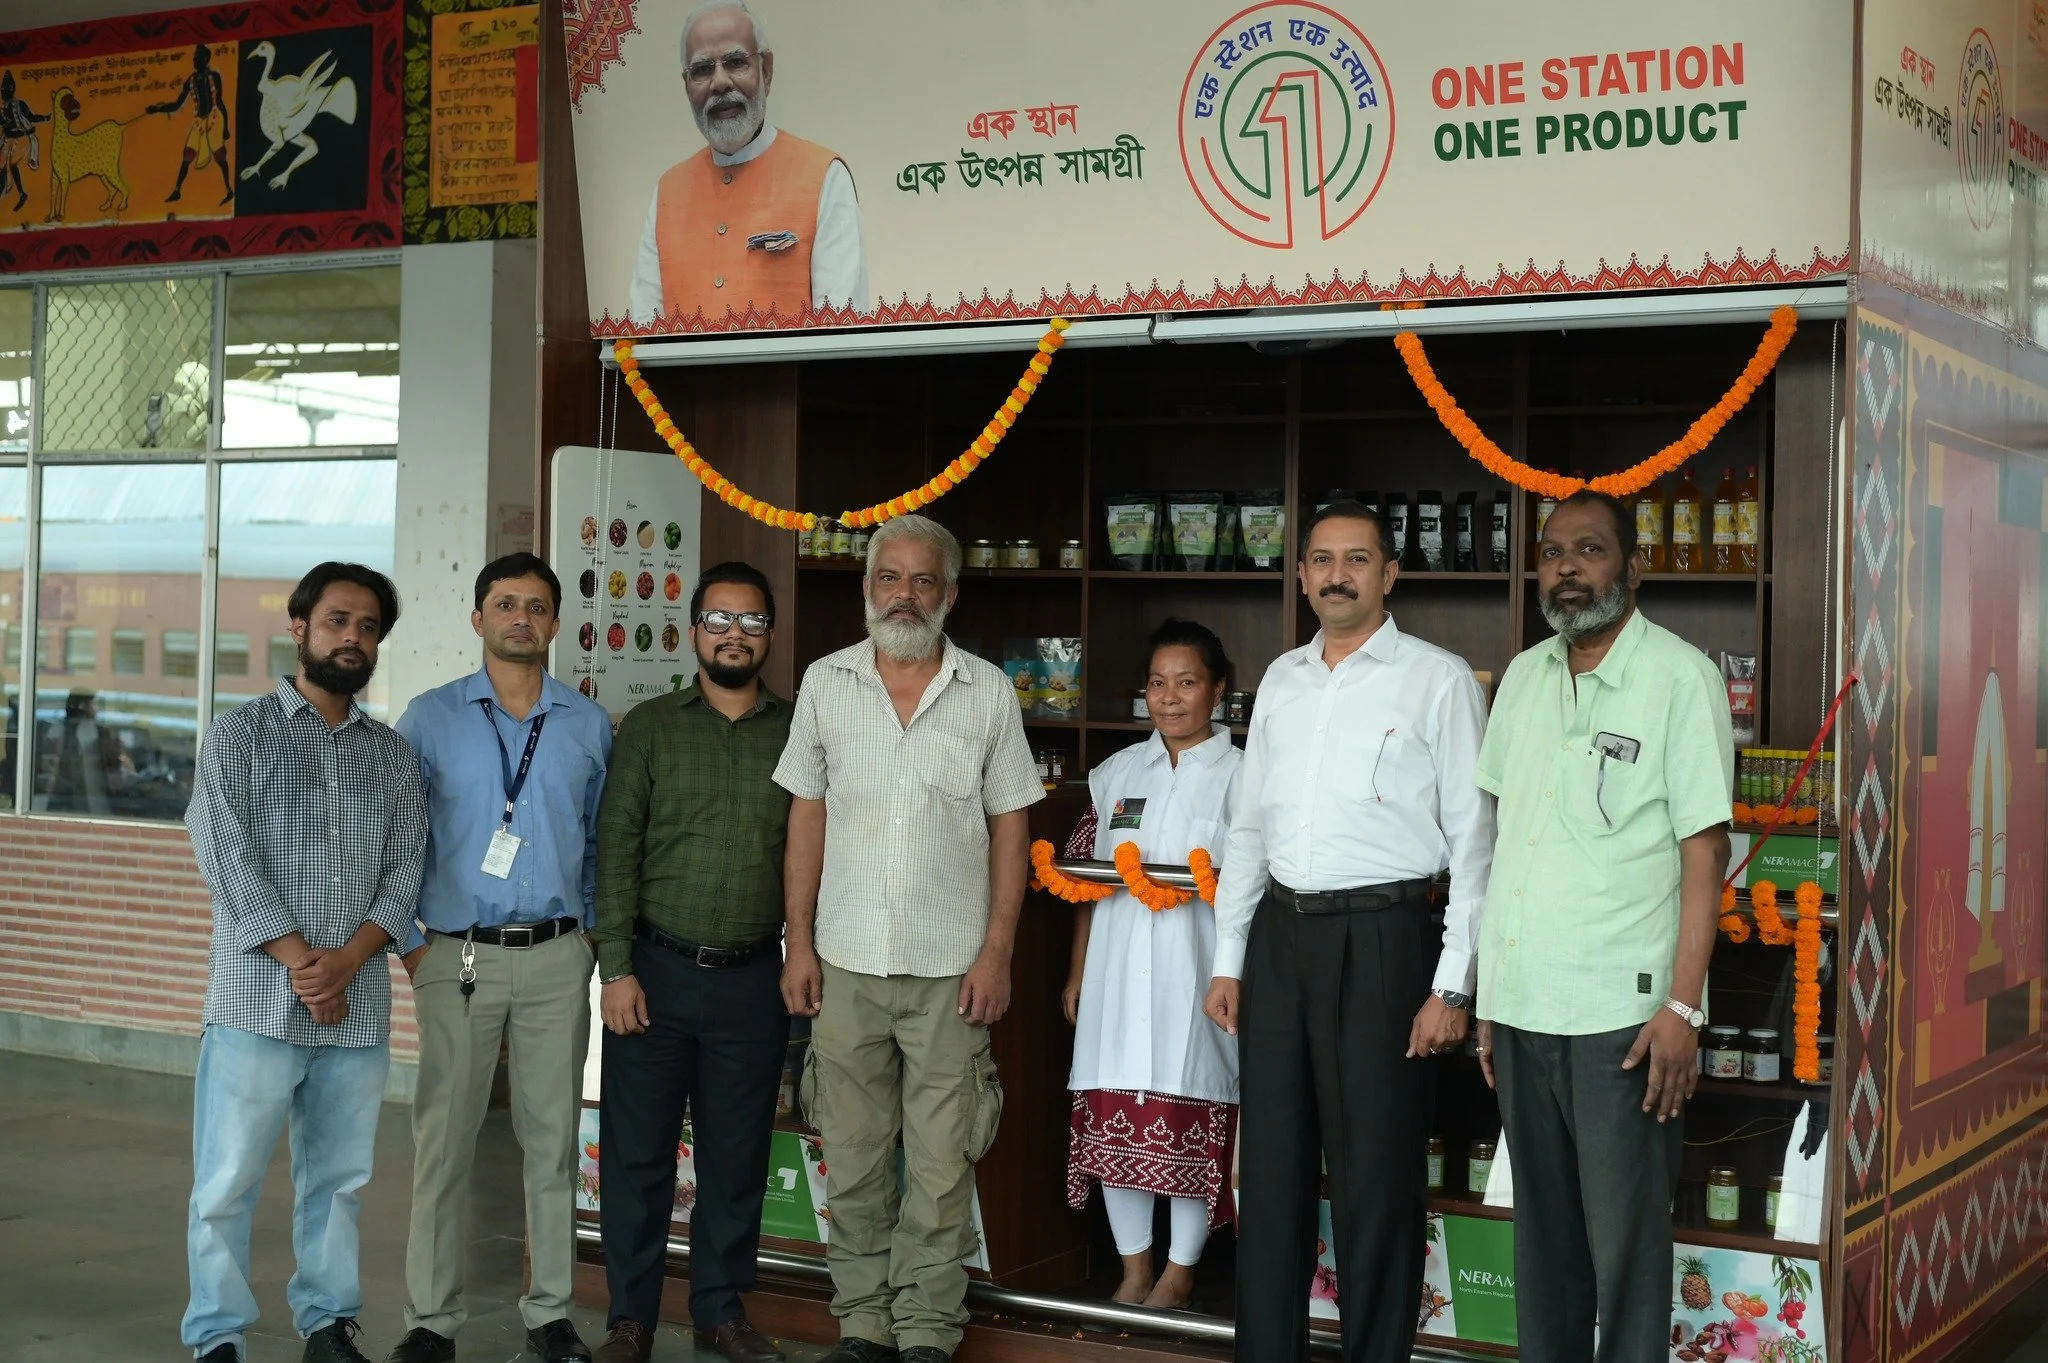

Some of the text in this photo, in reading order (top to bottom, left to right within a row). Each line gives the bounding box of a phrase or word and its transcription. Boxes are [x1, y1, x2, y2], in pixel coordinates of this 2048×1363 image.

[1195, 19, 1378, 120] एक स्टेशन एक उत्पाद
[1432, 41, 1746, 110] ONE STATION
[967, 102, 1080, 142] এক স্থান
[1433, 100, 1748, 162] ONE PRODUCT
[2009, 117, 2048, 172] ONE STAT
[896, 161, 947, 196] এক
[955, 147, 1046, 189] উৎপন্ন
[2008, 159, 2026, 196] ONE
[627, 682, 668, 694] NERAMAC
[1761, 856, 1816, 868] NERAMAC
[1459, 1268, 1516, 1288] NERAM
